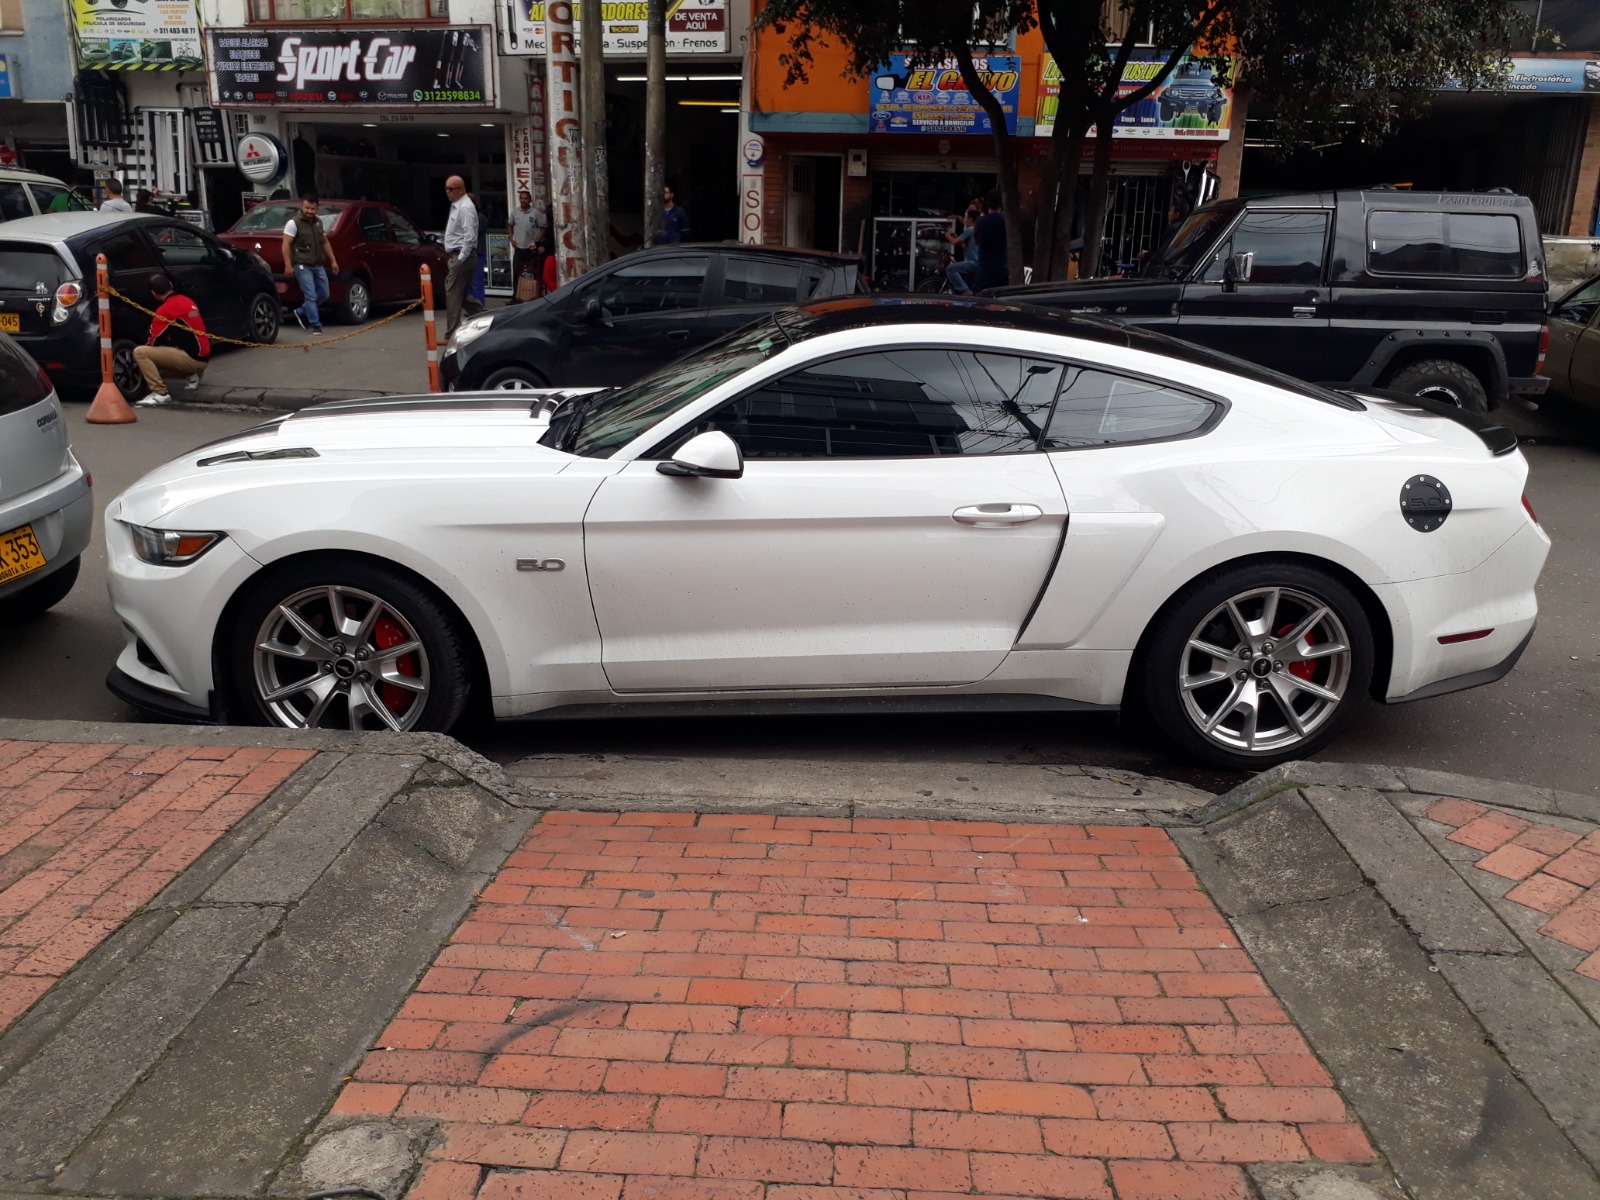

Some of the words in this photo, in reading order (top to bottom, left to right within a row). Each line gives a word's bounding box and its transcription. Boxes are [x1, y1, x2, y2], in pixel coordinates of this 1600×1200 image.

[241, 38, 269, 48] ALARMAS
[683, 39, 718, 48] Frenos
[228, 49, 260, 60] BLOQUEOS
[276, 36, 361, 90] Sport
[363, 37, 417, 81] Car
[906, 71, 936, 91] EL
[938, 71, 1018, 92] CAVO
[1515, 74, 1572, 84] Electrostática
[424, 91, 480, 101] 3123598834
[1, 316, 18, 326] 045
[517, 557, 566, 571] 5.0
